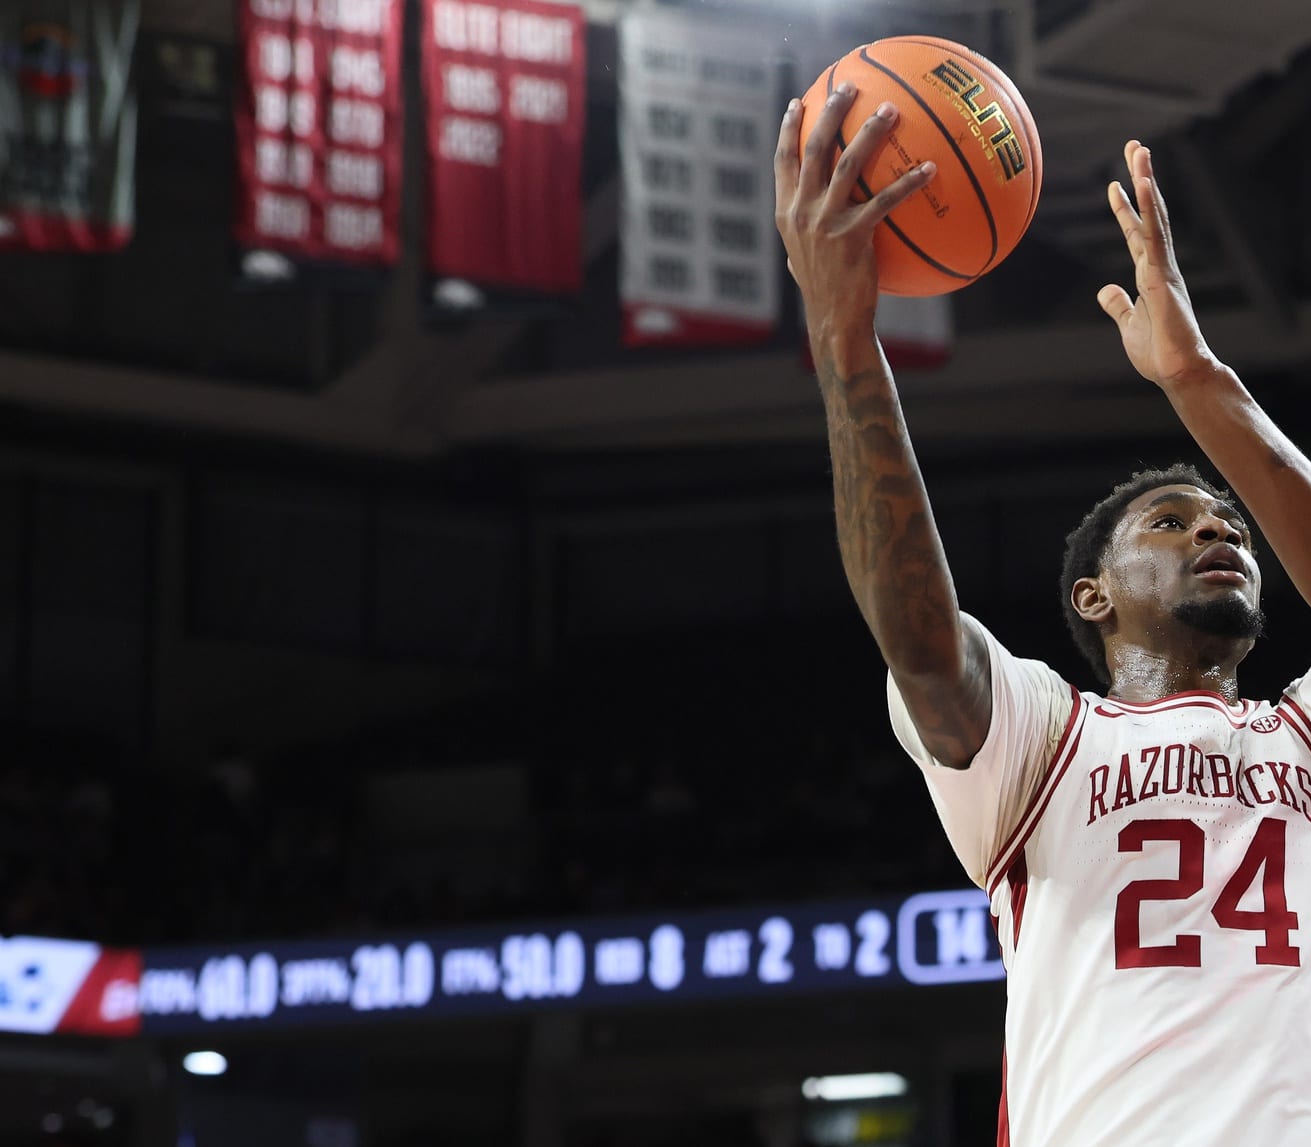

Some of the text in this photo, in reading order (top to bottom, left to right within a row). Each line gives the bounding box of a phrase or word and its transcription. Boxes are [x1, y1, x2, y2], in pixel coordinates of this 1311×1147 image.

[930, 58, 1026, 182] ELITE
[1251, 715, 1281, 733] SEC
[1114, 817, 1301, 970] 24
[757, 916, 794, 983] 2
[855, 909, 891, 977] 2
[933, 909, 988, 965] 14
